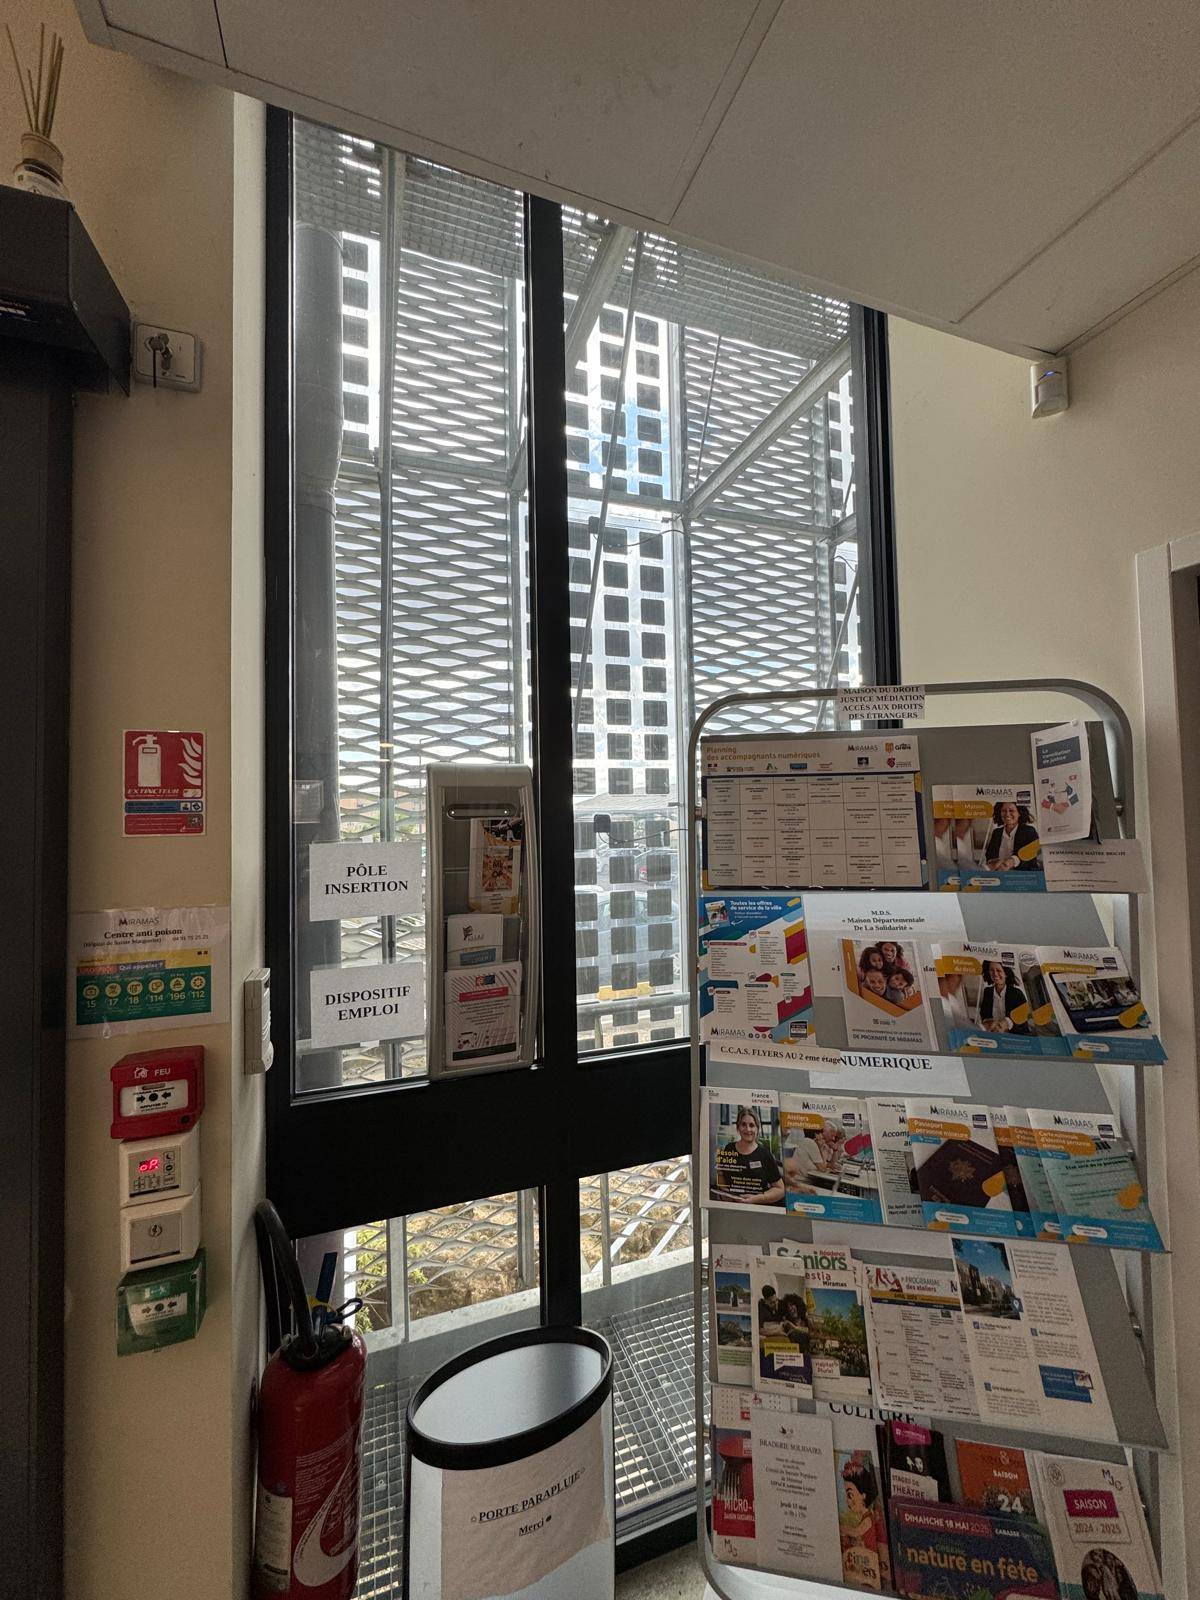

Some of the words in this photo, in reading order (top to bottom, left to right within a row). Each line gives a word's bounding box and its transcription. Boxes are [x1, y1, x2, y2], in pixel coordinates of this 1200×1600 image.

[843, 687, 877, 695] MAISON
[876, 694, 925, 702] MÉDIATION
[842, 703, 871, 711] ACCÈS
[866, 711, 918, 719] ÉTRANGERS
[847, 744, 878, 752] MIRAMAS
[720, 753, 777, 761] accompagnants
[777, 751, 821, 760] numériques
[976, 785, 1013, 796] MIRAMAS
[346, 863, 388, 877] PÔLE
[325, 880, 409, 895] INSERTION
[118, 917, 161, 926] MIRAMAS
[872, 917, 925, 925] Départementale
[103, 931, 134, 939] Centre
[136, 929, 153, 937] anti
[154, 927, 183, 938] poison
[963, 943, 999, 955] MIRAMAS
[1063, 950, 1099, 961] MIRAMAS
[132, 963, 158, 971] appelez
[149, 994, 164, 1002] 114
[170, 991, 186, 1000] 196
[191, 990, 205, 998] 112
[325, 985, 411, 1006] DISPOSITIF
[86, 1000, 96, 1008] 15
[108, 998, 118, 1006] 17
[129, 996, 139, 1005] 18
[338, 1003, 399, 1021] EMPLOI
[710, 1026, 746, 1037] MIRAMAS
[720, 1046, 751, 1056] C.C.A.S.
[751, 1048, 784, 1059] FLYERS
[784, 1051, 797, 1059] AU
[798, 1051, 804, 1060] 2
[804, 1054, 820, 1062] eme
[821, 1053, 841, 1065] étage
[840, 1054, 933, 1072] NUMERIQUE
[154, 1067, 171, 1076] FEU
[802, 1101, 837, 1111] MIRAMAS
[930, 1105, 968, 1118] MIRAMAS
[914, 1121, 943, 1130] Passeport
[1053, 1115, 1094, 1128] MIRAMAS
[716, 1149, 739, 1157] Besoin
[715, 1156, 737, 1164] d'aide
[759, 1438, 789, 1450] BRADERIE
[992, 1469, 1019, 1480] SAISON
[479, 1503, 519, 1523] PORTE
[521, 1470, 581, 1511] PARAPLUIE
[997, 1493, 1025, 1514] 24
[1073, 1497, 1108, 1510] SAISON
[518, 1518, 545, 1537] Merci
[904, 1513, 944, 1528] DIMANCHE
[945, 1520, 953, 1529] 18
[955, 1521, 970, 1531] MAI
[1073, 1522, 1095, 1534] 2024
[906, 1546, 967, 1572] nature
[970, 1558, 995, 1577] en
[997, 1556, 1039, 1584] fête
